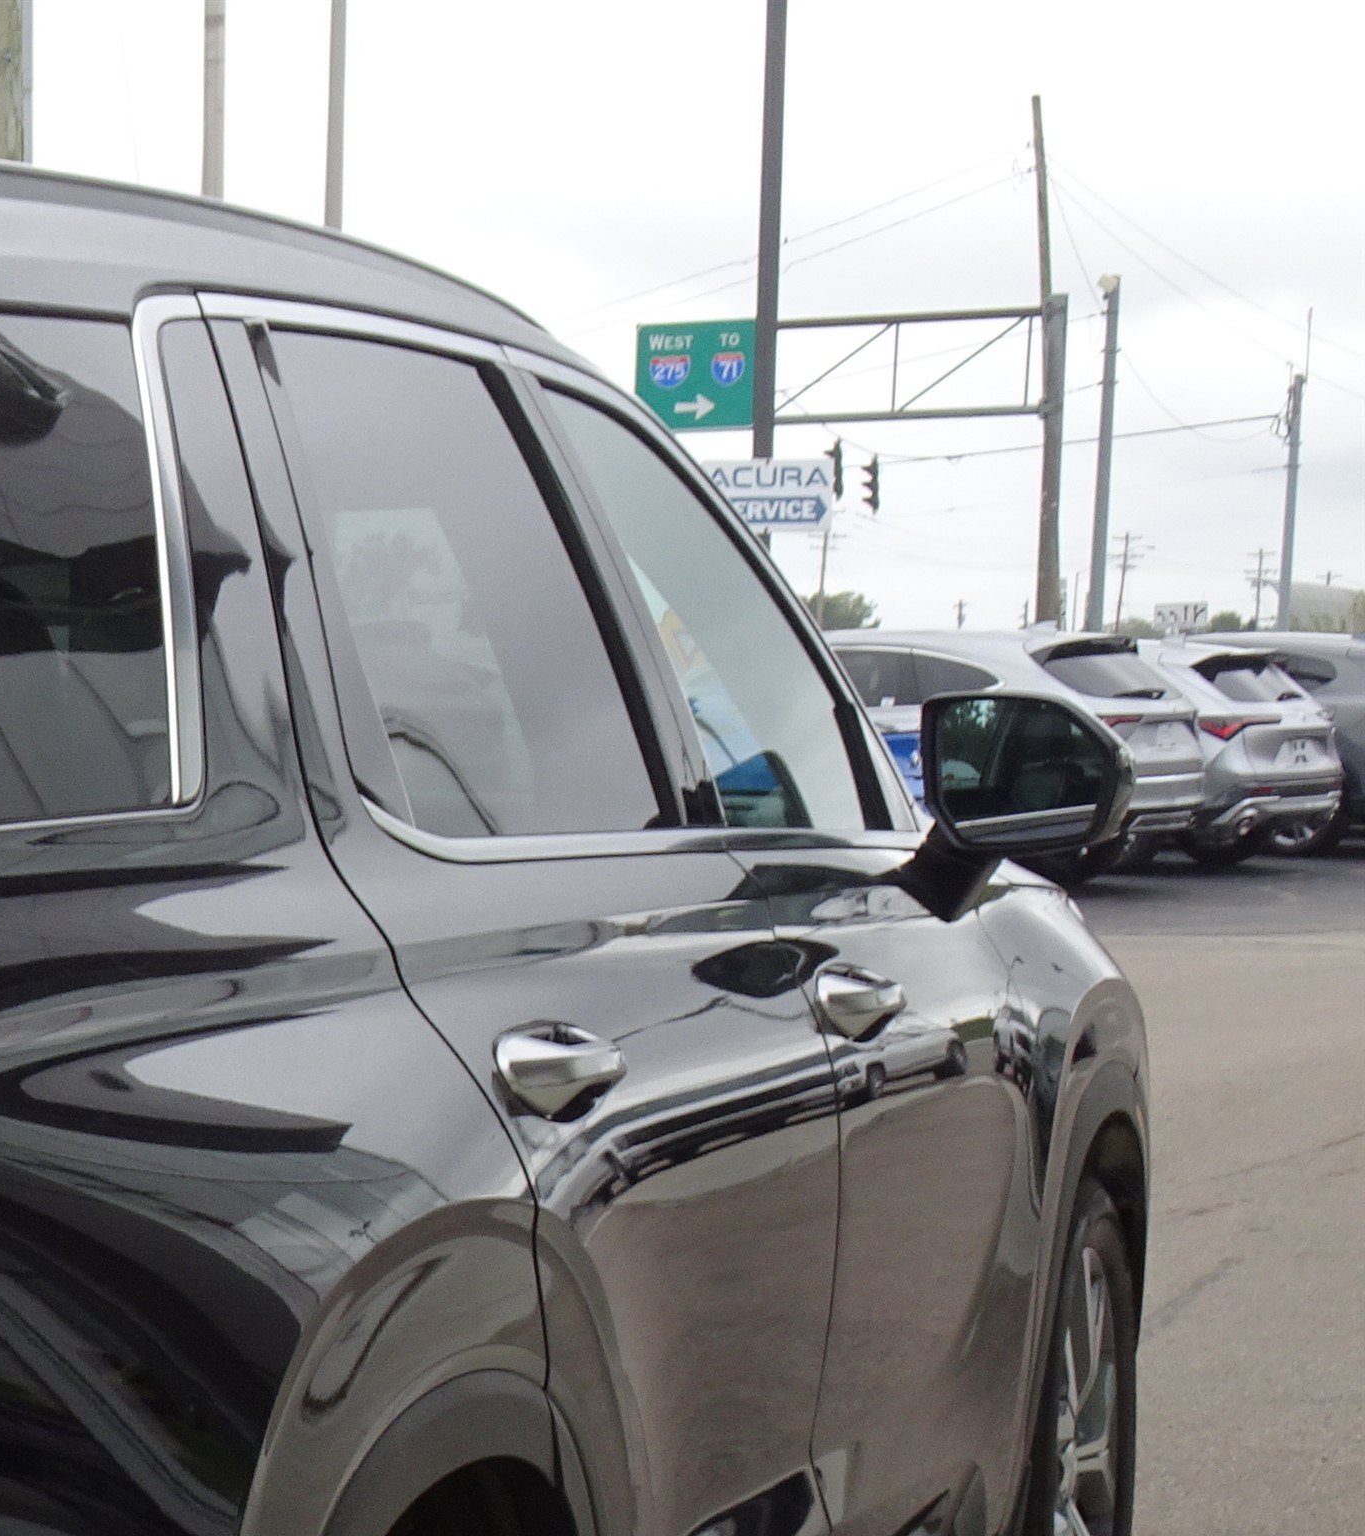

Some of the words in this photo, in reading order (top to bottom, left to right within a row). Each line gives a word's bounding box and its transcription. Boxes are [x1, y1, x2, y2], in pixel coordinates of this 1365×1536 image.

[649, 333, 693, 351] WEST
[719, 332, 741, 348] TO
[653, 363, 687, 381] 275
[719, 361, 739, 380] 71
[711, 466, 829, 488] ACURA
[731, 500, 817, 520] ERVICE
